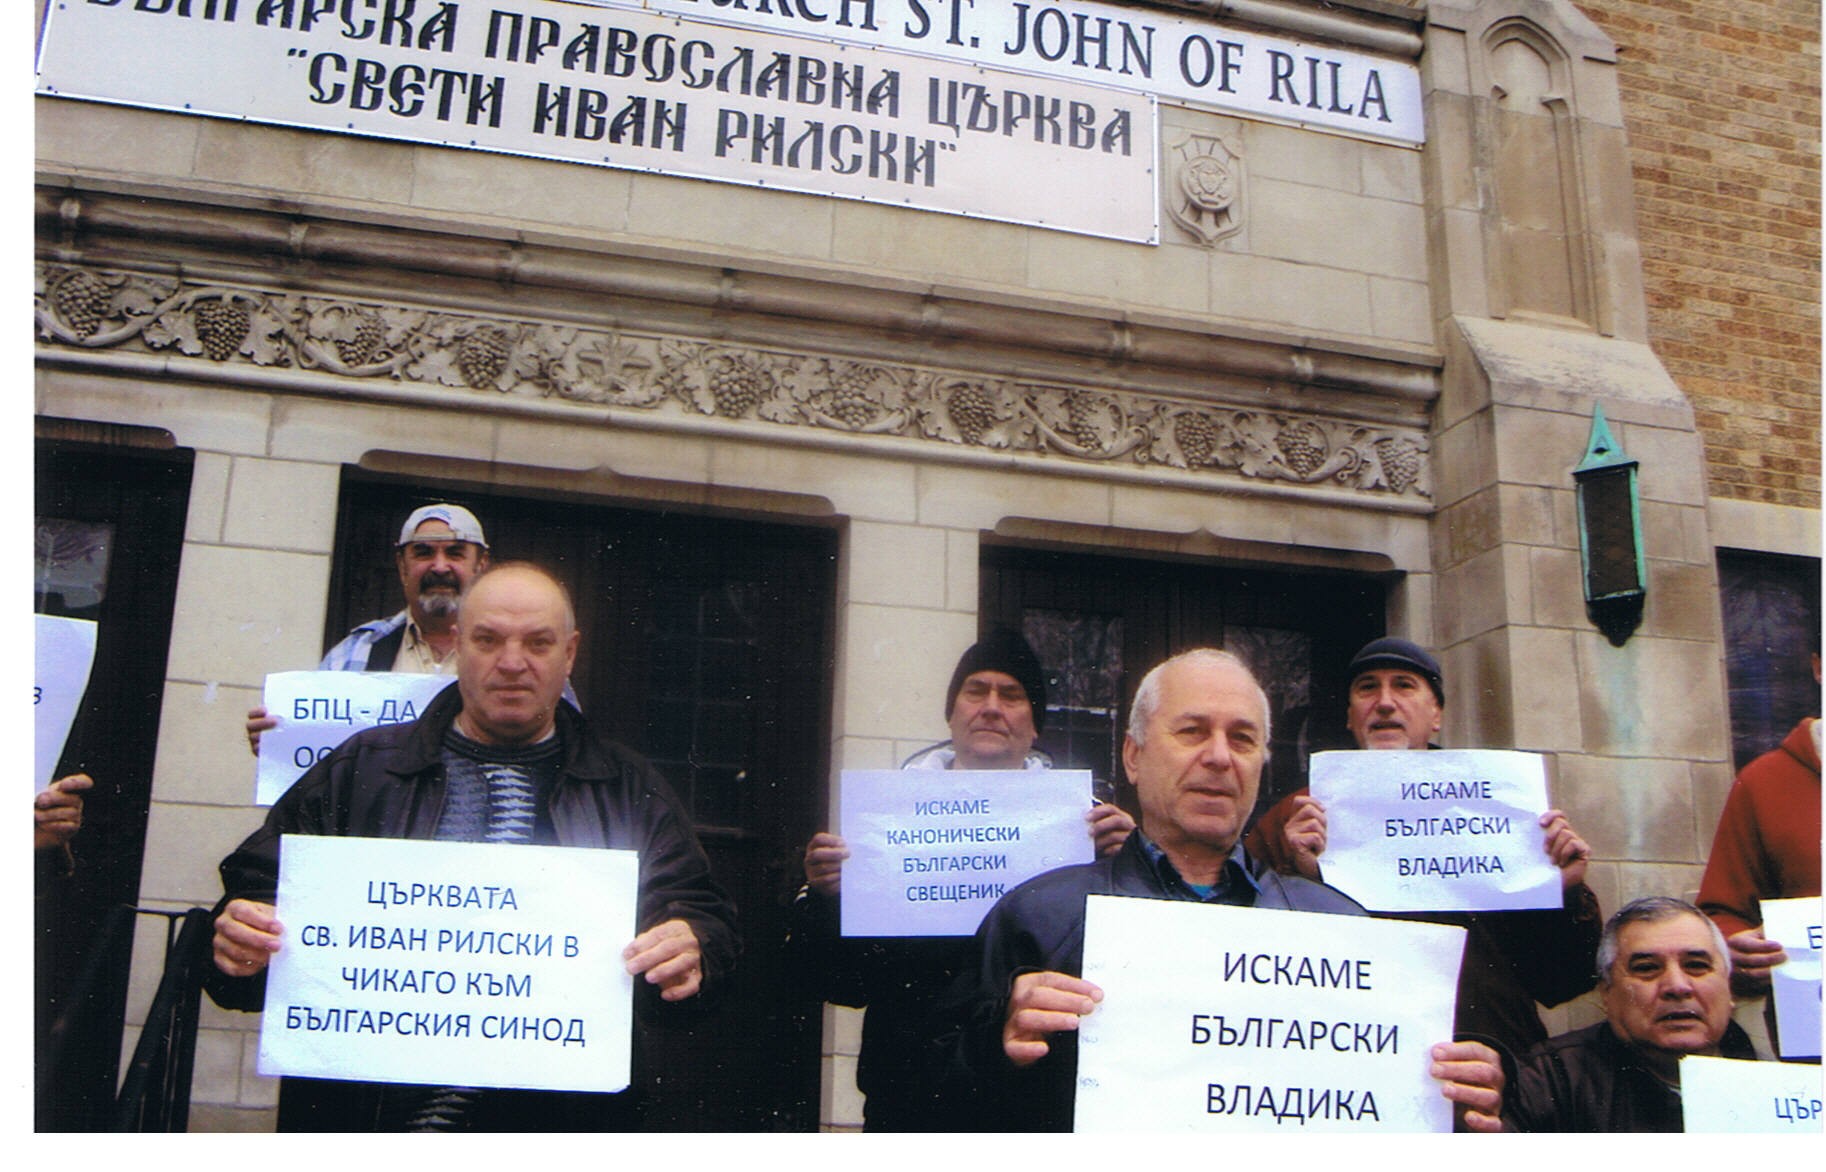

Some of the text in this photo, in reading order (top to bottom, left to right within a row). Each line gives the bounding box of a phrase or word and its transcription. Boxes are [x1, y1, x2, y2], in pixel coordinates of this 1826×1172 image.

[905, 0, 979, 47] ST.
[1005, 3, 1155, 78] JOHN
[1180, 35, 1243, 93] OF
[1267, 50, 1391, 122] RILA
[485, 10, 899, 117] ПРАВОСЛАВНА
[930, 78, 1130, 155] ЦЪРКВА
[533, 83, 687, 151] ИВАН
[294, 698, 353, 725] БПЦ
[377, 700, 418, 725] ДА
[1401, 781, 1492, 800] ИСКАМЕ
[916, 799, 989, 815] ИСКАМЕ
[887, 827, 1020, 844] КАНОНИЧЕСКИ
[1386, 812, 1510, 837] БЪЛГАРСКИ
[904, 855, 1006, 872] БЪЛГАРСКИ
[1398, 856, 1504, 879] ВЛАДИКА
[368, 881, 518, 910] ЦЪРКВАТА
[907, 883, 1004, 902] СВЕЩЕНИК
[301, 925, 579, 957] СВ. ИВАН РИЛСКИ В
[342, 967, 531, 997] ЧИКАГО КЪМ
[1224, 952, 1372, 990] ИСКАМЕ
[286, 1006, 585, 1047] БЪЛГАРСКИЯ СИНОД
[1192, 1014, 1398, 1054] БЪЛГАРСКИ
[1207, 1083, 1380, 1126] ВЛАДИКА
